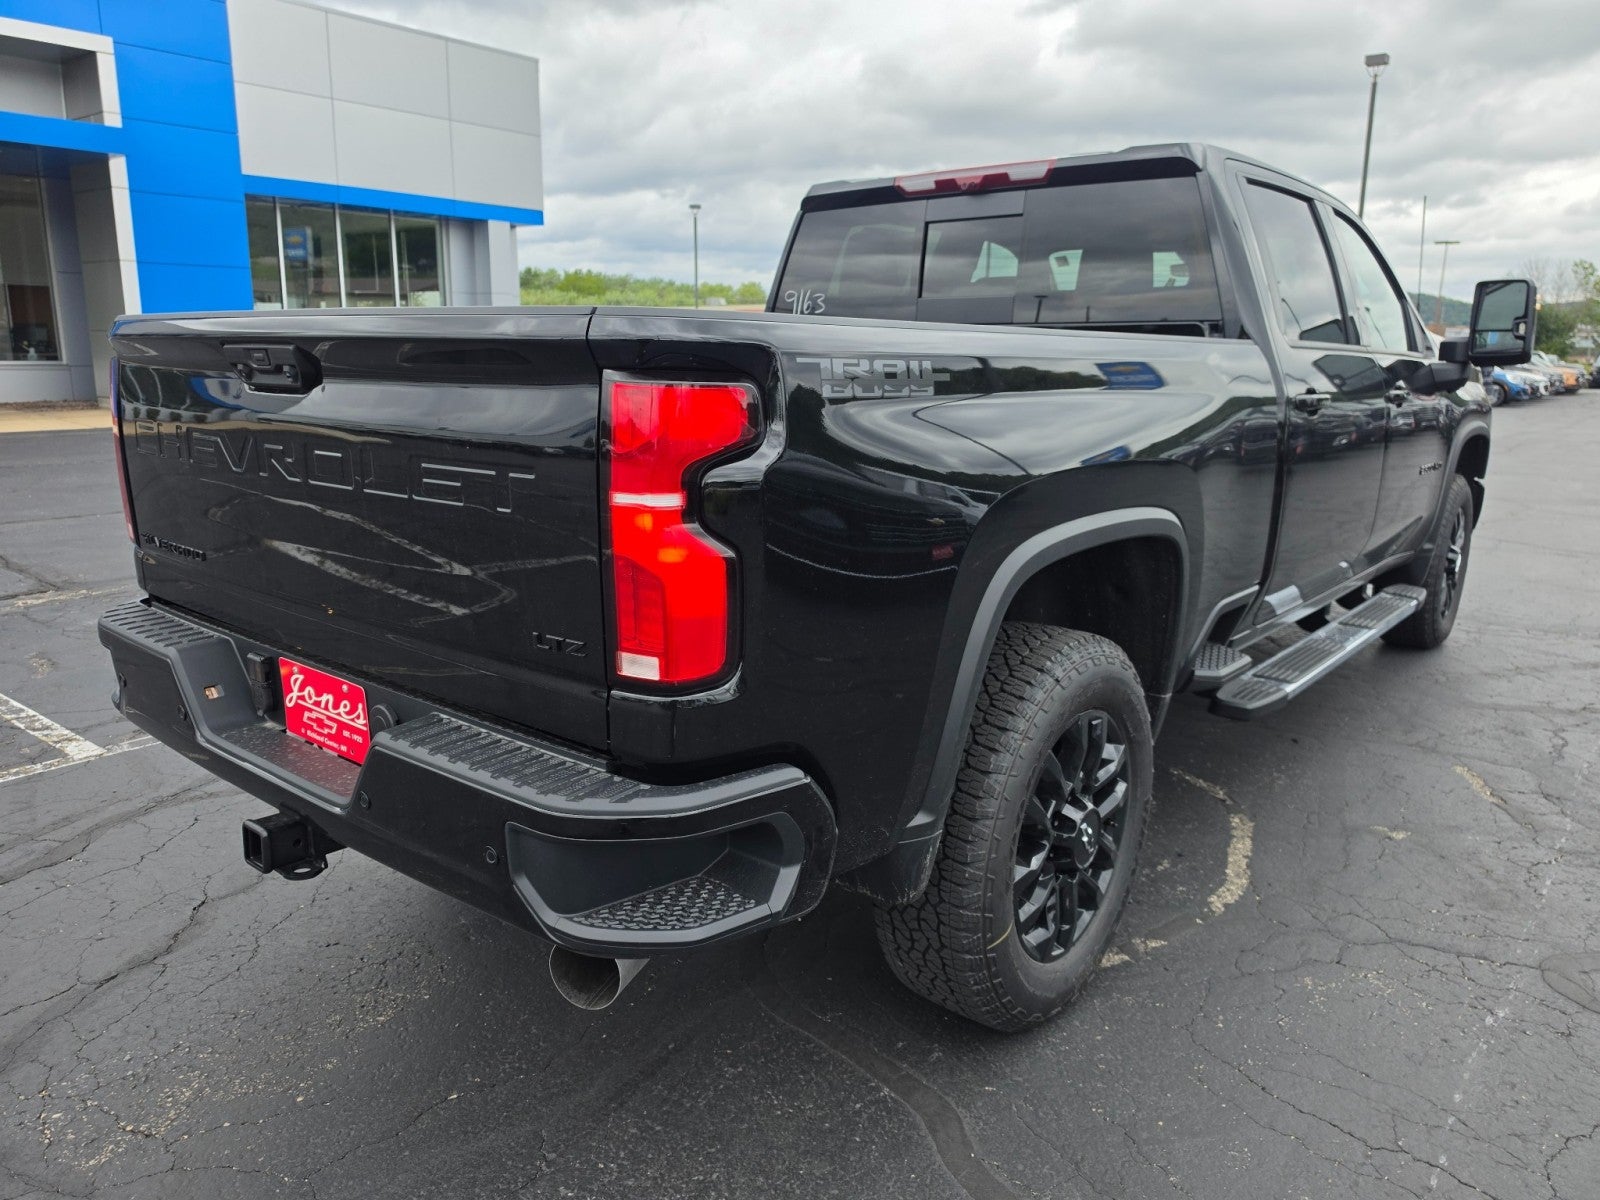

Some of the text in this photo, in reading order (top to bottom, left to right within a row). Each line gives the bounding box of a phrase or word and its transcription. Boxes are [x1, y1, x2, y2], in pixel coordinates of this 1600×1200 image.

[784, 290, 826, 315] 9163
[796, 357, 950, 380] TRAIL
[821, 379, 934, 399] BOSS
[135, 420, 535, 513] CHEVROLET
[532, 631, 587, 657] LTZ
[286, 674, 366, 724] Jones
